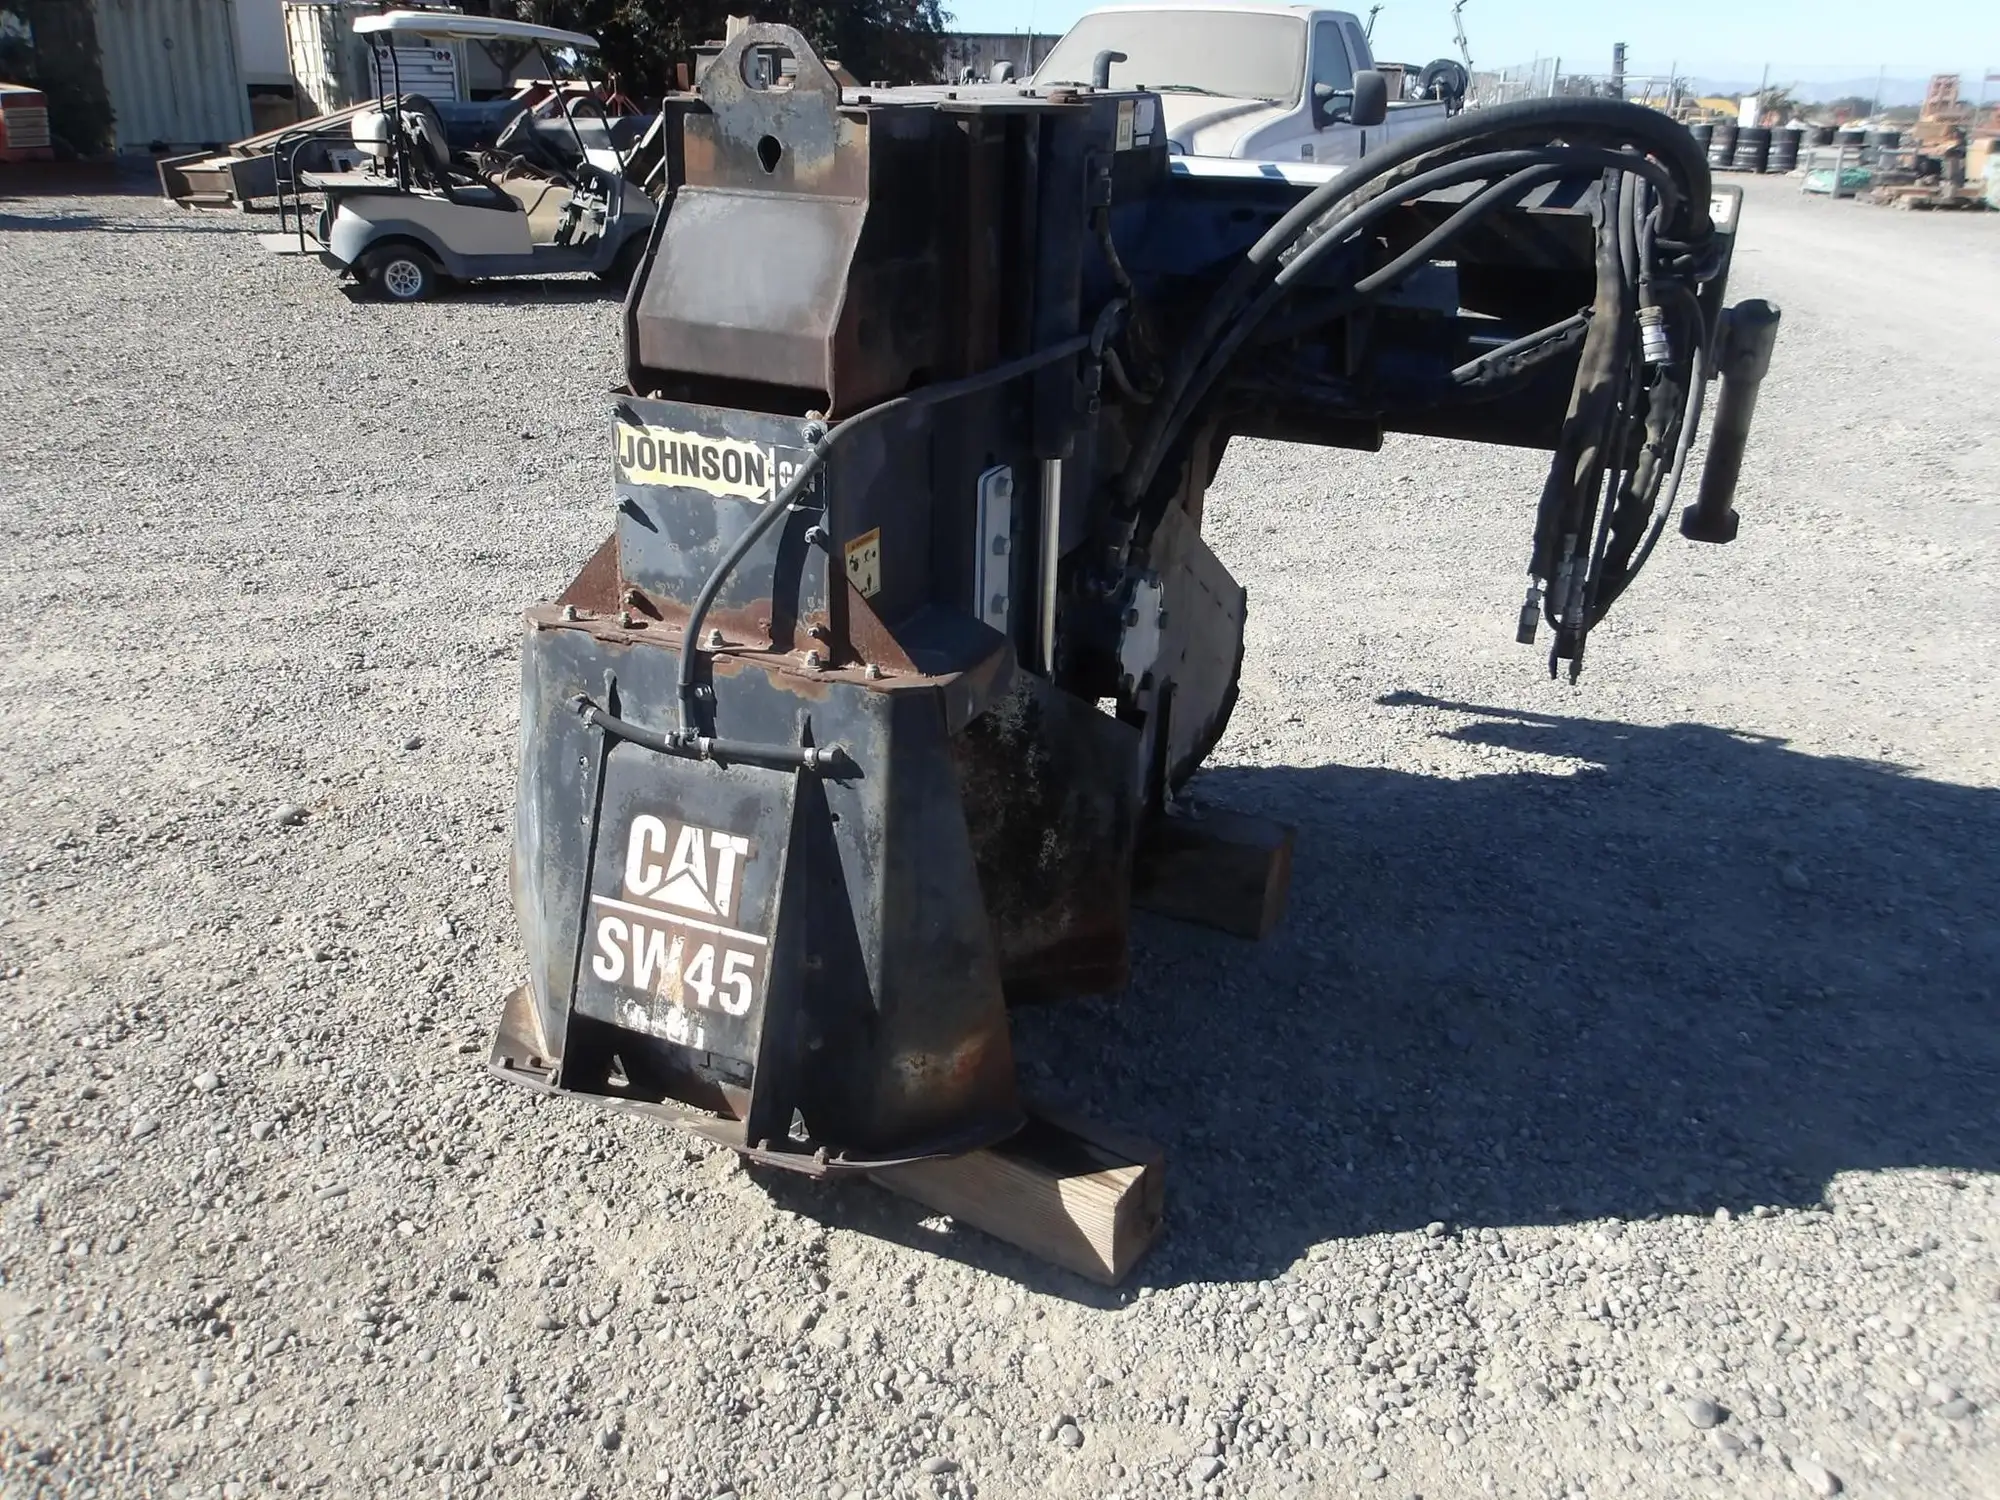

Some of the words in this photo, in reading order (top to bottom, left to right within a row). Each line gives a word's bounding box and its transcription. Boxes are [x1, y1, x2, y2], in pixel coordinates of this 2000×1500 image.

[620, 435, 764, 487] JOHNSON
[625, 814, 749, 917] CAT
[592, 916, 756, 1016] SW45
